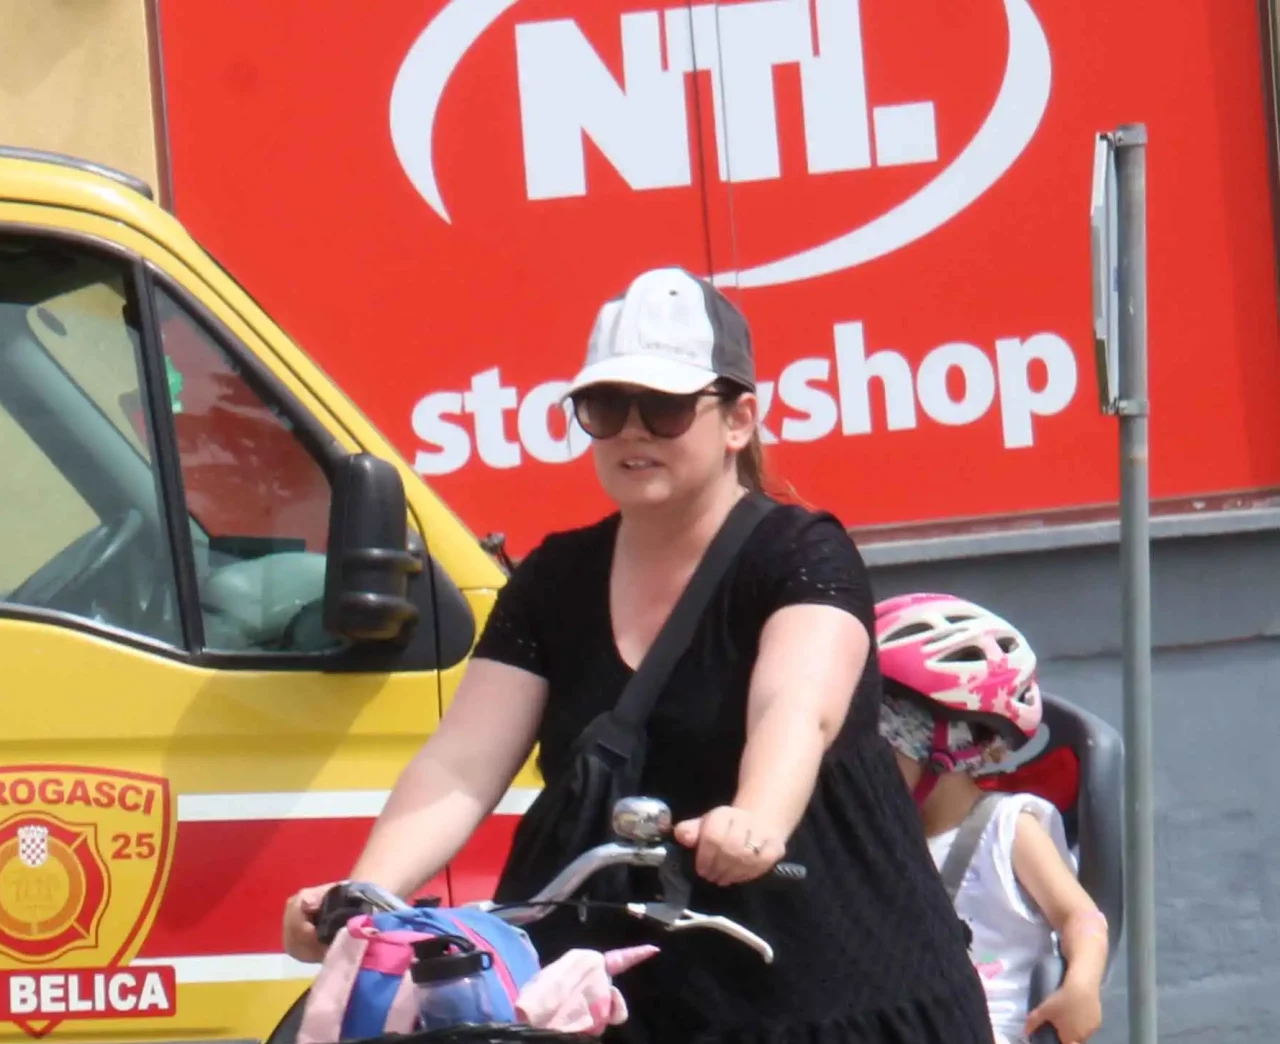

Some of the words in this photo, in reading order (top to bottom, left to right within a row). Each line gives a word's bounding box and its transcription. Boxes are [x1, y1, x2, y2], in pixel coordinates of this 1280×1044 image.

[410, 321, 1078, 477] stoshop
[111, 832, 156, 861] 25
[9, 972, 170, 1014] BELICA
